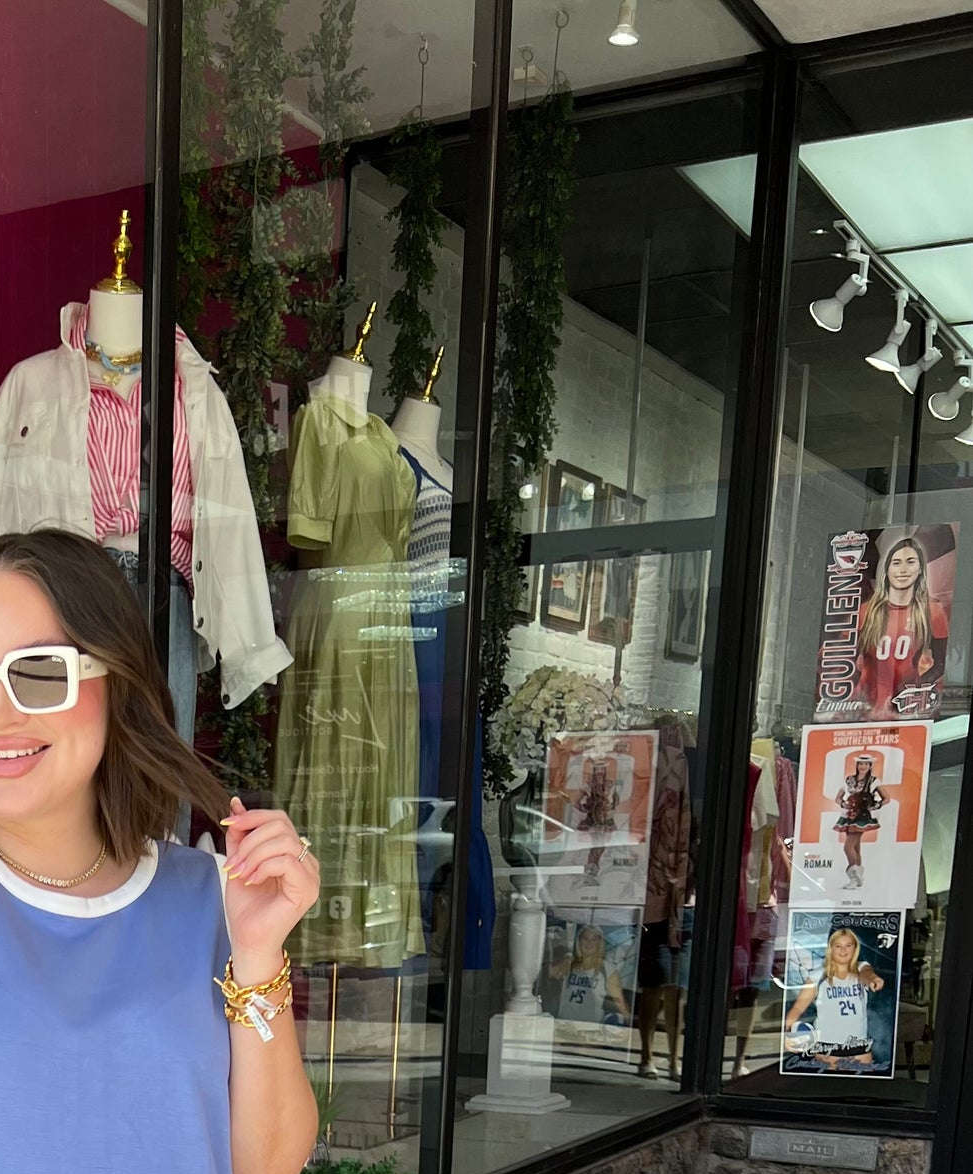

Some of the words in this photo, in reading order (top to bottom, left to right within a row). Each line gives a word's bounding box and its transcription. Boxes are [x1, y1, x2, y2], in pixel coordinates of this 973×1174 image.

[819, 572, 863, 702] GUILLEN
[876, 635, 911, 660] 00
[833, 736, 873, 746] SOUTHERN
[875, 734, 899, 744] STARS
[804, 860, 833, 869] ROMAN
[793, 914, 830, 932] LADY
[831, 913, 900, 934] COUGARS
[839, 1000, 857, 1016] 24
[792, 1144, 830, 1155] MAIL
